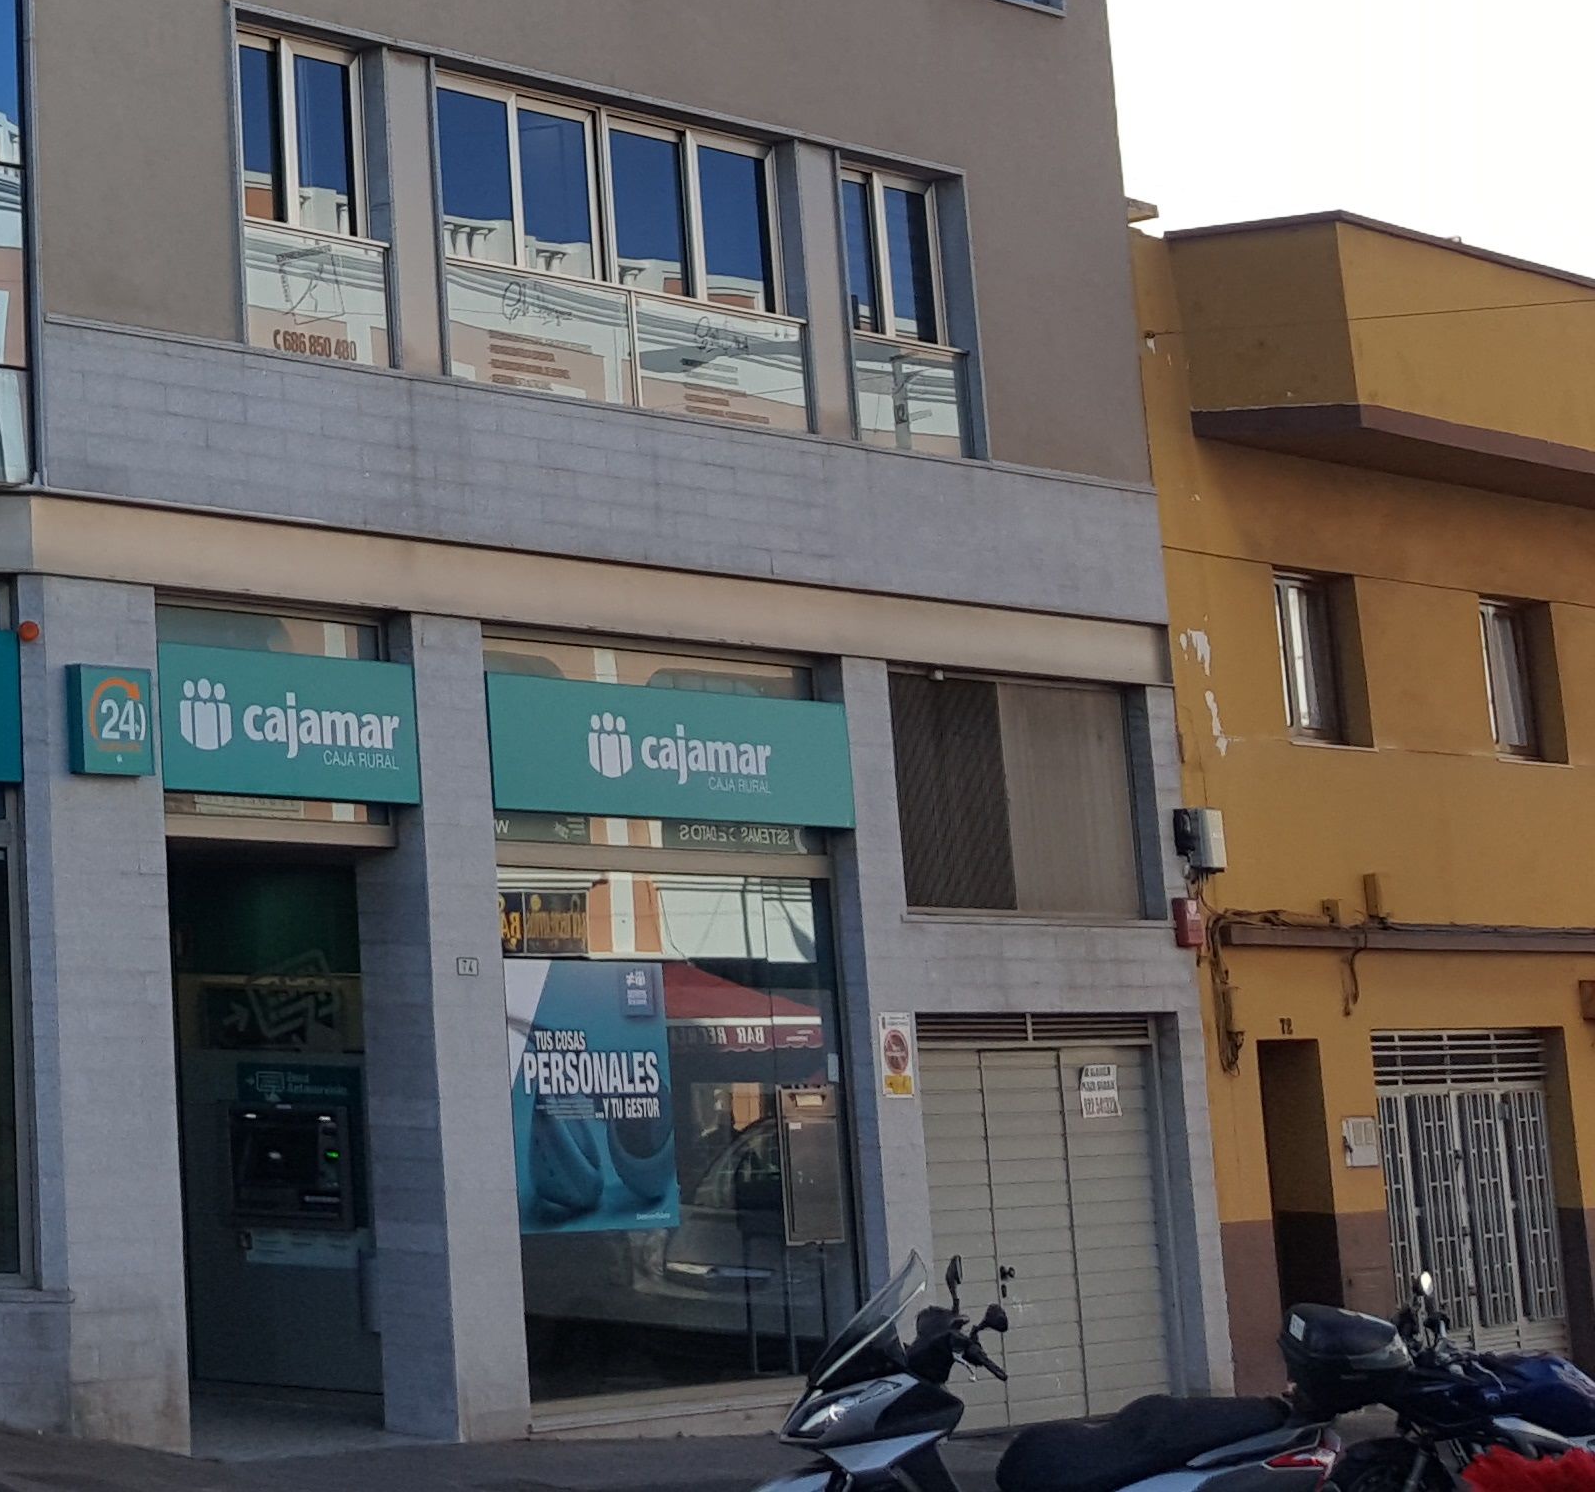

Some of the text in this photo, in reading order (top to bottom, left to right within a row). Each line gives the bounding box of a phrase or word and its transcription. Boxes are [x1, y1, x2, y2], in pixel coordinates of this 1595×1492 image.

[282, 330, 357, 361] 686 850 480
[243, 691, 400, 759] cajamar
[323, 749, 400, 771] CAJA RURAL
[640, 723, 772, 786] cajamar
[708, 776, 772, 796] CAJA RURAL
[534, 1030, 586, 1051] TUS COSAS
[522, 1051, 660, 1095] PERSONALES
[611, 1098, 623, 1119] TU
[625, 1097, 660, 1119] GESTOR
